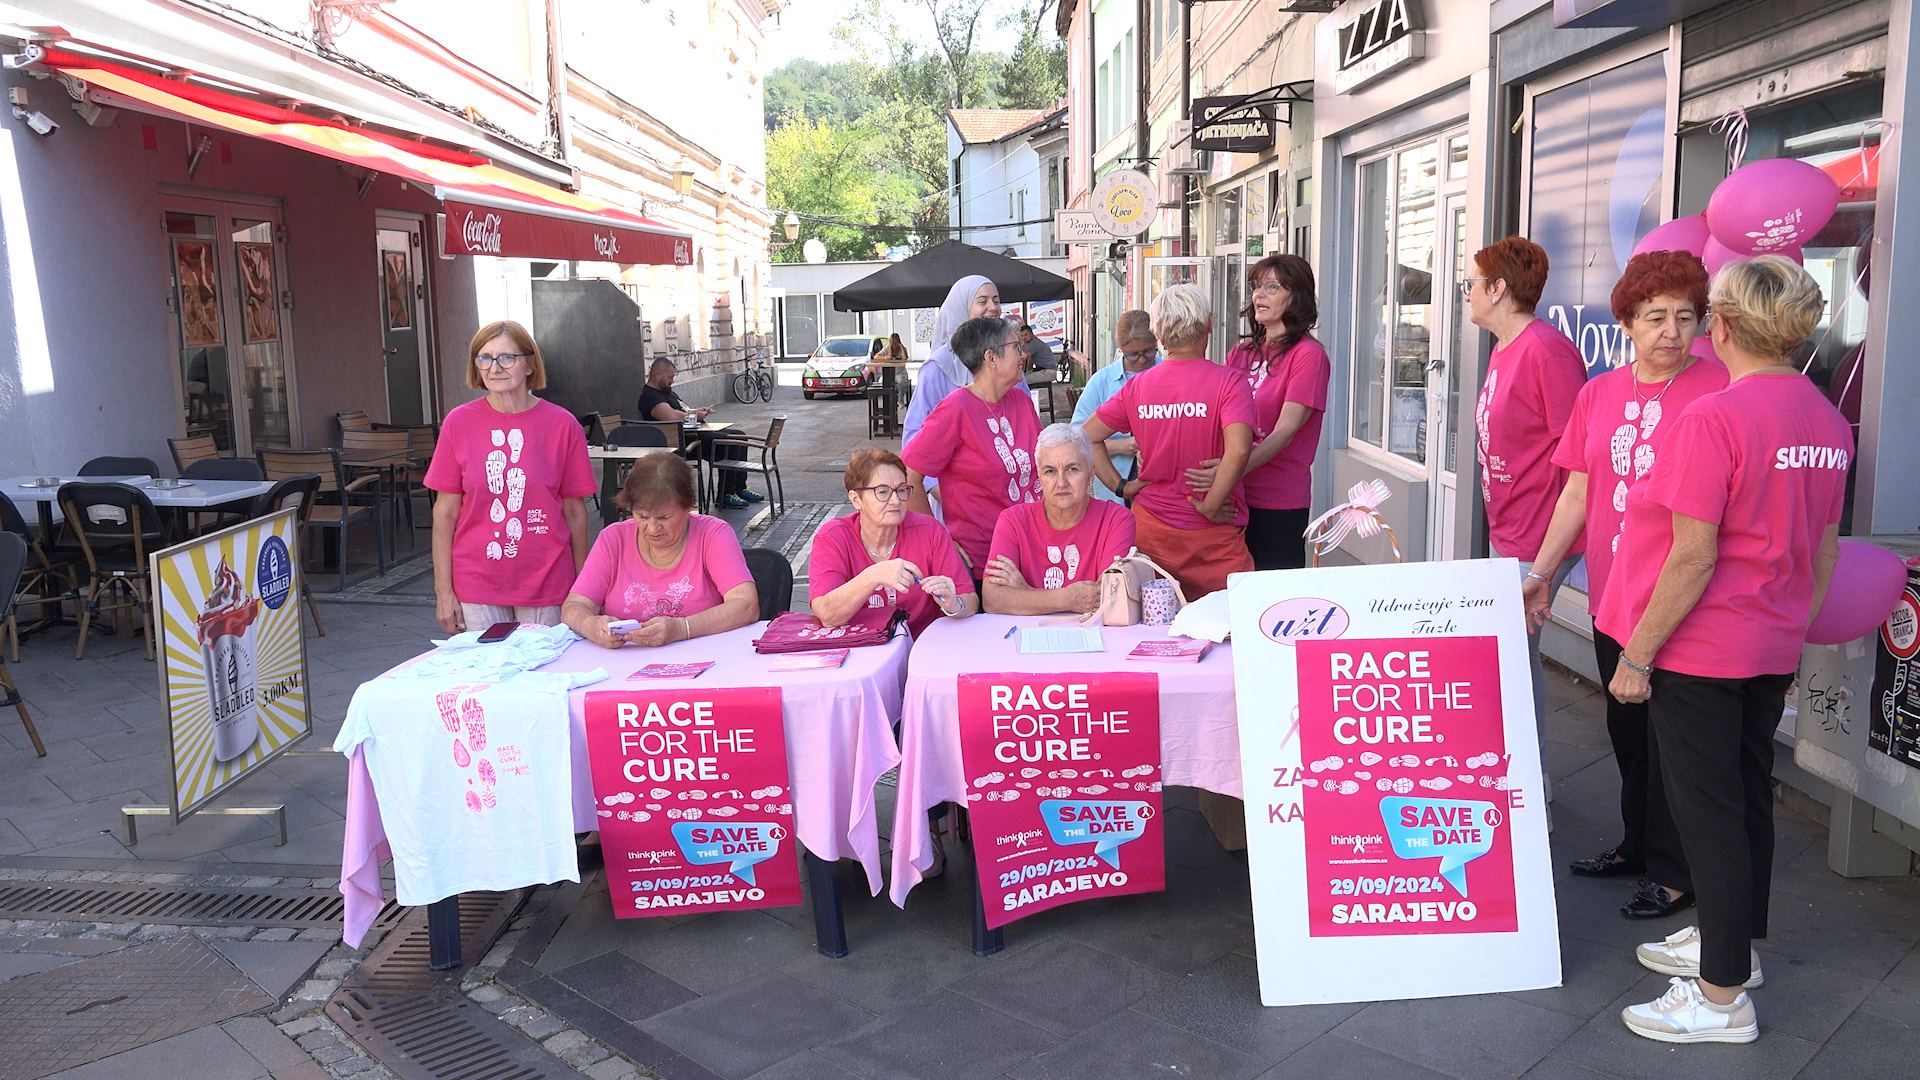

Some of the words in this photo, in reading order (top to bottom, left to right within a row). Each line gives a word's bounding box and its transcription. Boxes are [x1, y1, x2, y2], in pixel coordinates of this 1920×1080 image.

[1138, 402, 1208, 420] SURVIVOR
[1614, 424, 1638, 440] WITH
[1610, 435, 1636, 454] EVERY
[1634, 444, 1654, 458] WE
[486, 460, 506, 476] EVERY
[1612, 451, 1631, 476] STEP
[487, 474, 504, 494] STEP
[1368, 598, 1454, 616] Udruženje
[1459, 595, 1495, 608] žena
[1272, 606, 1338, 637] užt
[1412, 619, 1458, 635] Tuzle
[1892, 624, 1914, 639] GRANICA
[1330, 650, 1431, 680] RACE
[262, 672, 298, 708] 3.00KM
[990, 684, 1089, 711] RACE
[1332, 684, 1402, 712] FOR
[1406, 682, 1472, 710] THE
[214, 688, 254, 722] SLADOLED
[436, 692, 460, 712] EVERY
[462, 698, 483, 713] WE
[440, 708, 461, 733] STEP
[617, 701, 715, 728] RACE
[993, 714, 1060, 738] FOR
[1065, 711, 1130, 734] THE
[465, 722, 486, 736] EACH
[496, 744, 514, 753] RACE
[620, 730, 688, 756] FOR
[692, 728, 756, 753] THE
[1058, 806, 1127, 823] SAVE
[1400, 806, 1473, 828] SAVE
[690, 827, 760, 844] SAVE
[996, 832, 1018, 846] think
[1024, 828, 1043, 844] pink
[1064, 828, 1085, 836] THE
[1088, 820, 1134, 835] DATE
[1405, 838, 1428, 848] THE
[1432, 828, 1482, 846] DATE
[696, 850, 719, 858] THE
[722, 841, 768, 855] DATE
[1330, 835, 1356, 845] think
[1362, 834, 1382, 846] pink
[628, 850, 650, 860] think
[656, 850, 676, 860] pink
[999, 855, 1098, 888] 29/09/2024
[630, 874, 734, 892] 29/09/2024
[1003, 872, 1128, 912] SARAJEVO
[1330, 875, 1444, 896] 29/09/2024
[634, 887, 765, 910] SARAJEVO
[1332, 901, 1477, 924] SARAJEVO
